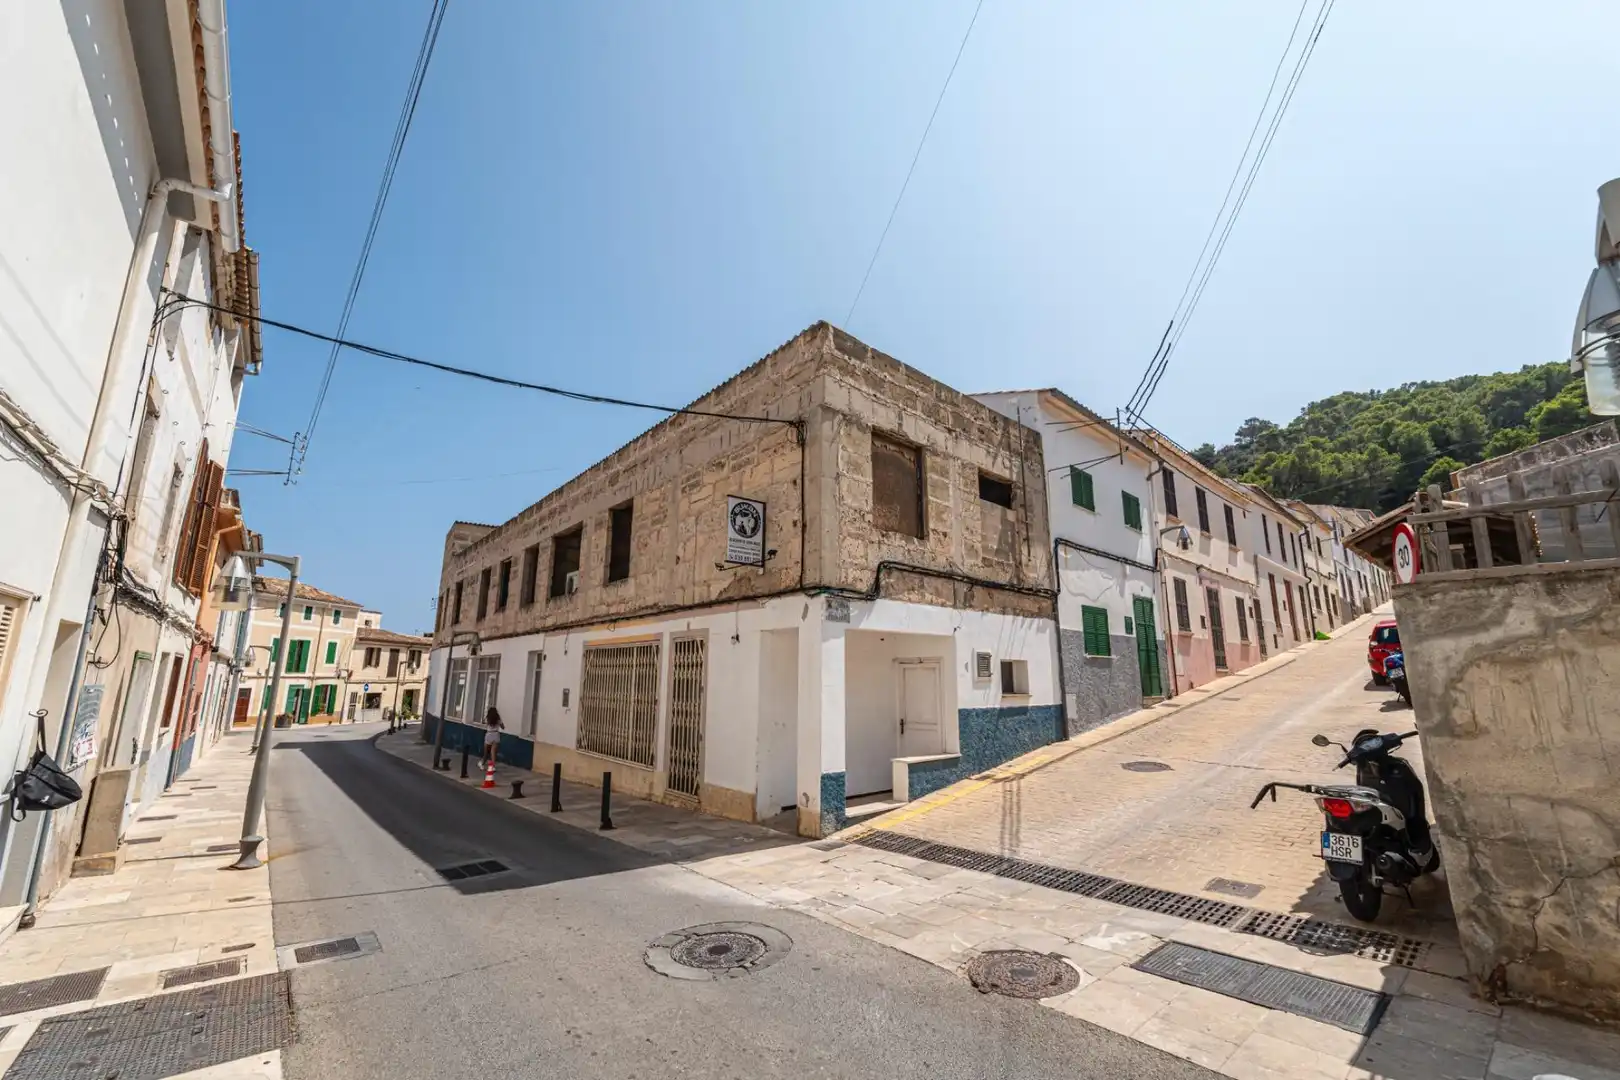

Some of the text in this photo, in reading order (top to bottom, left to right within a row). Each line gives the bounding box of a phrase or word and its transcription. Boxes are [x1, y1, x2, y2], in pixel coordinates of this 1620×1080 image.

[1398, 545, 1410, 568] 30
[1331, 835, 1359, 848] 3616
[1331, 846, 1352, 858] HSR
